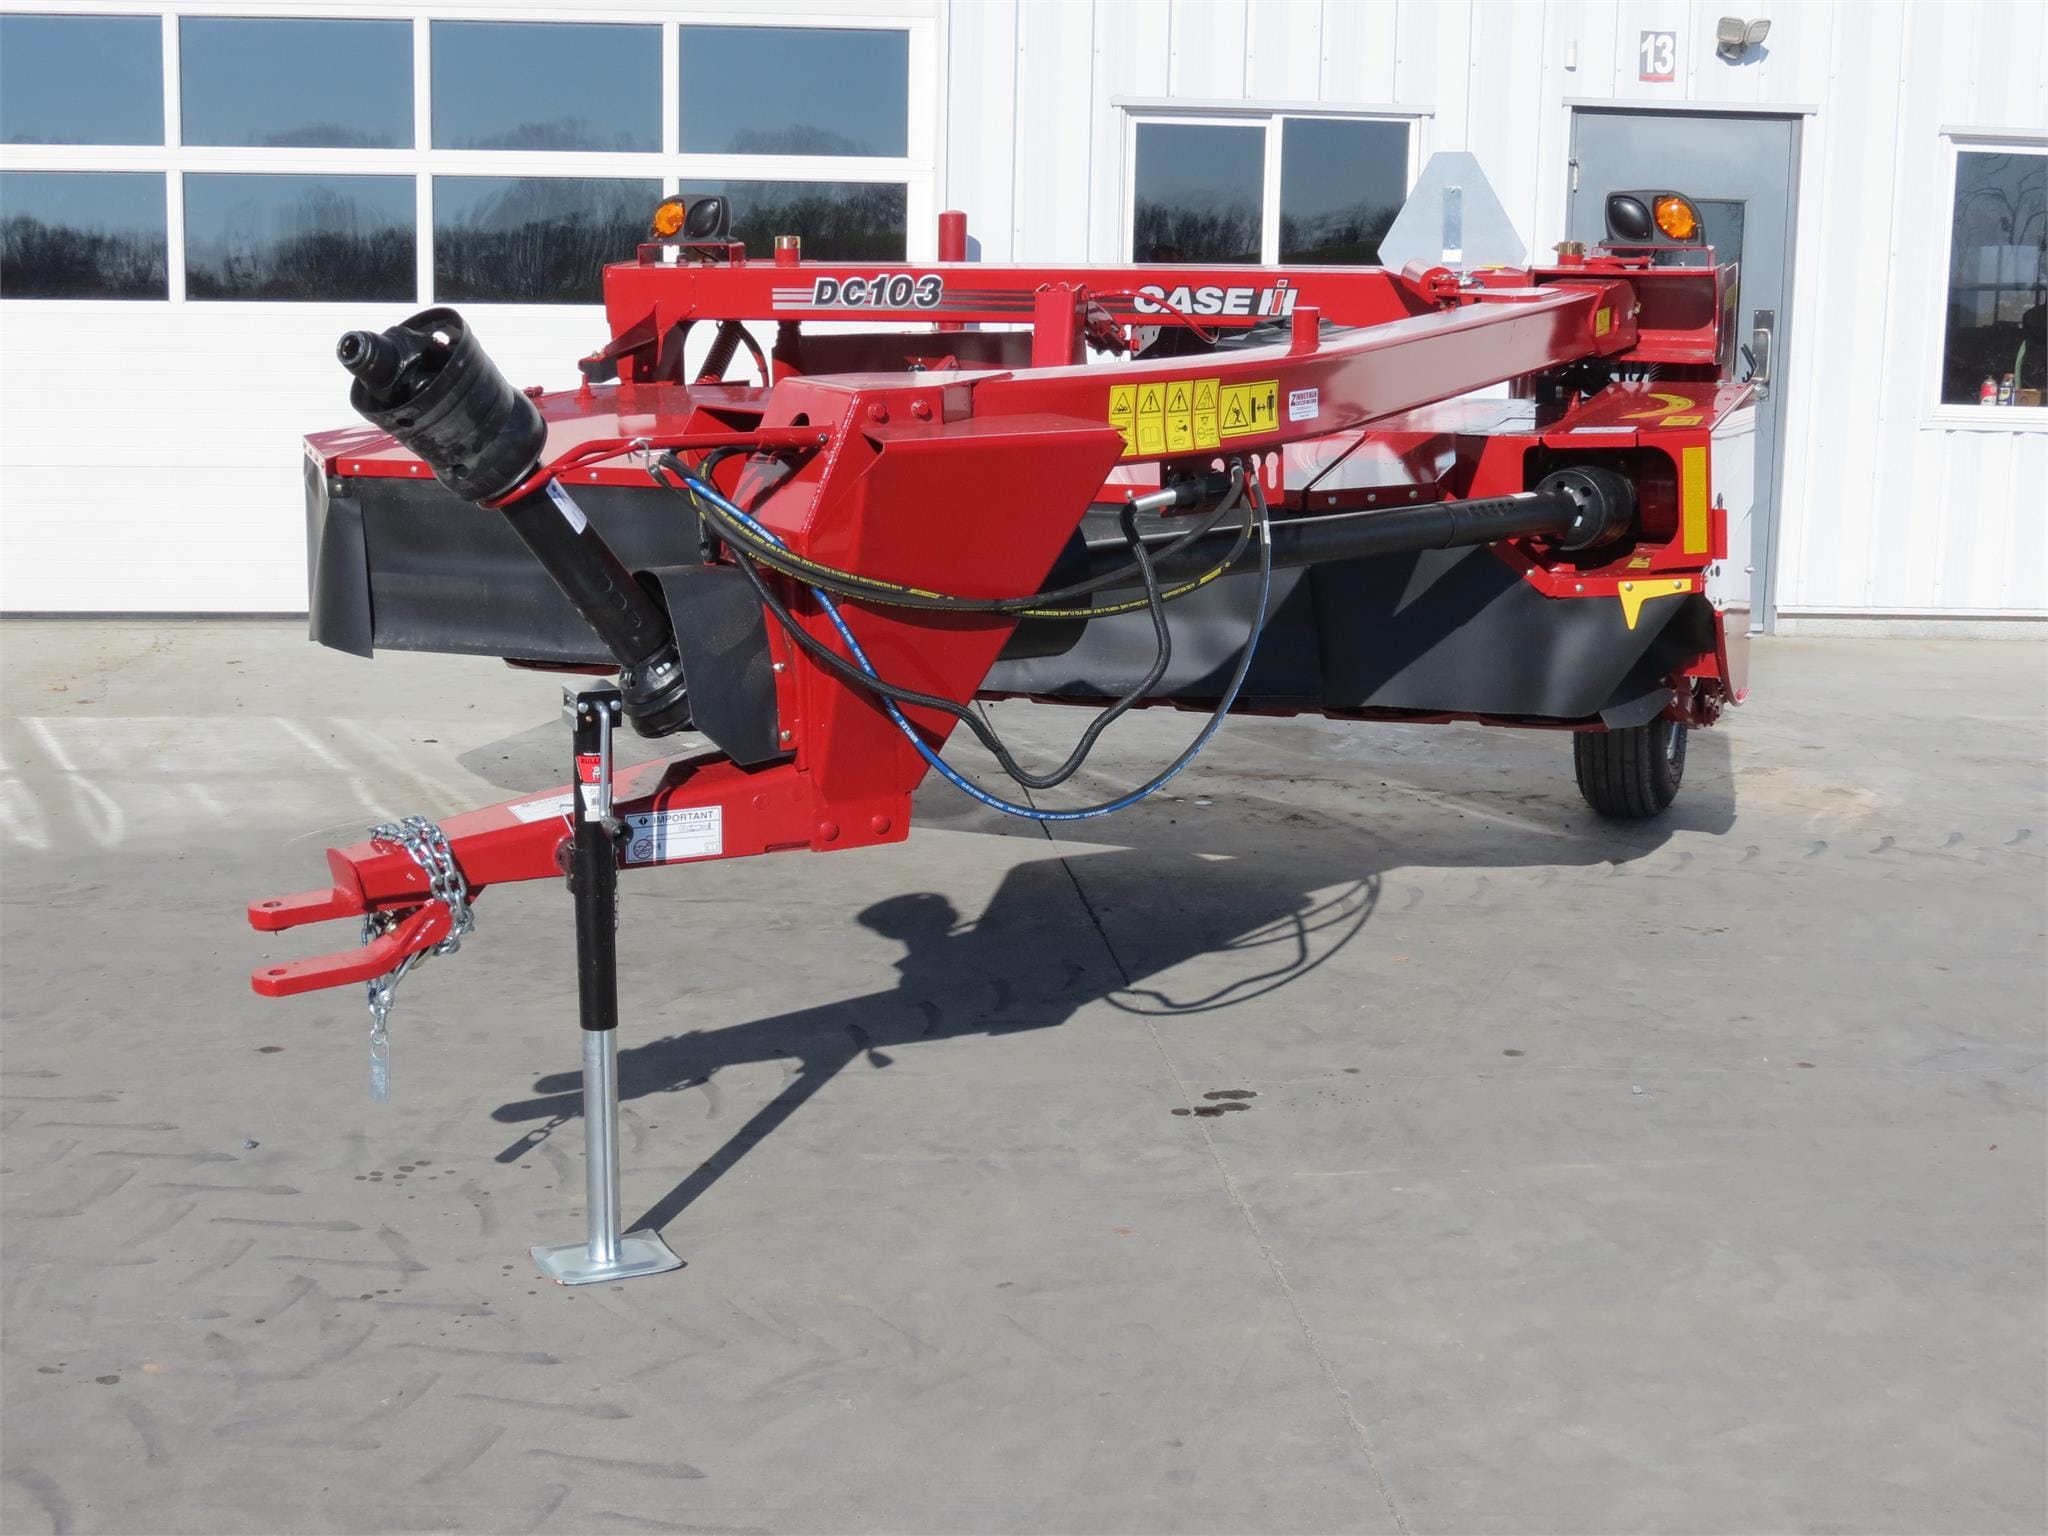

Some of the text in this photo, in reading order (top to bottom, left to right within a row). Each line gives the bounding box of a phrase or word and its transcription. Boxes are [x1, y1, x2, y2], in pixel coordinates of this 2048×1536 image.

[1641, 34, 1675, 74] 13
[812, 273, 944, 308] DC103
[1133, 285, 1255, 316] CASE
[653, 810, 714, 824] IMPORTANT
